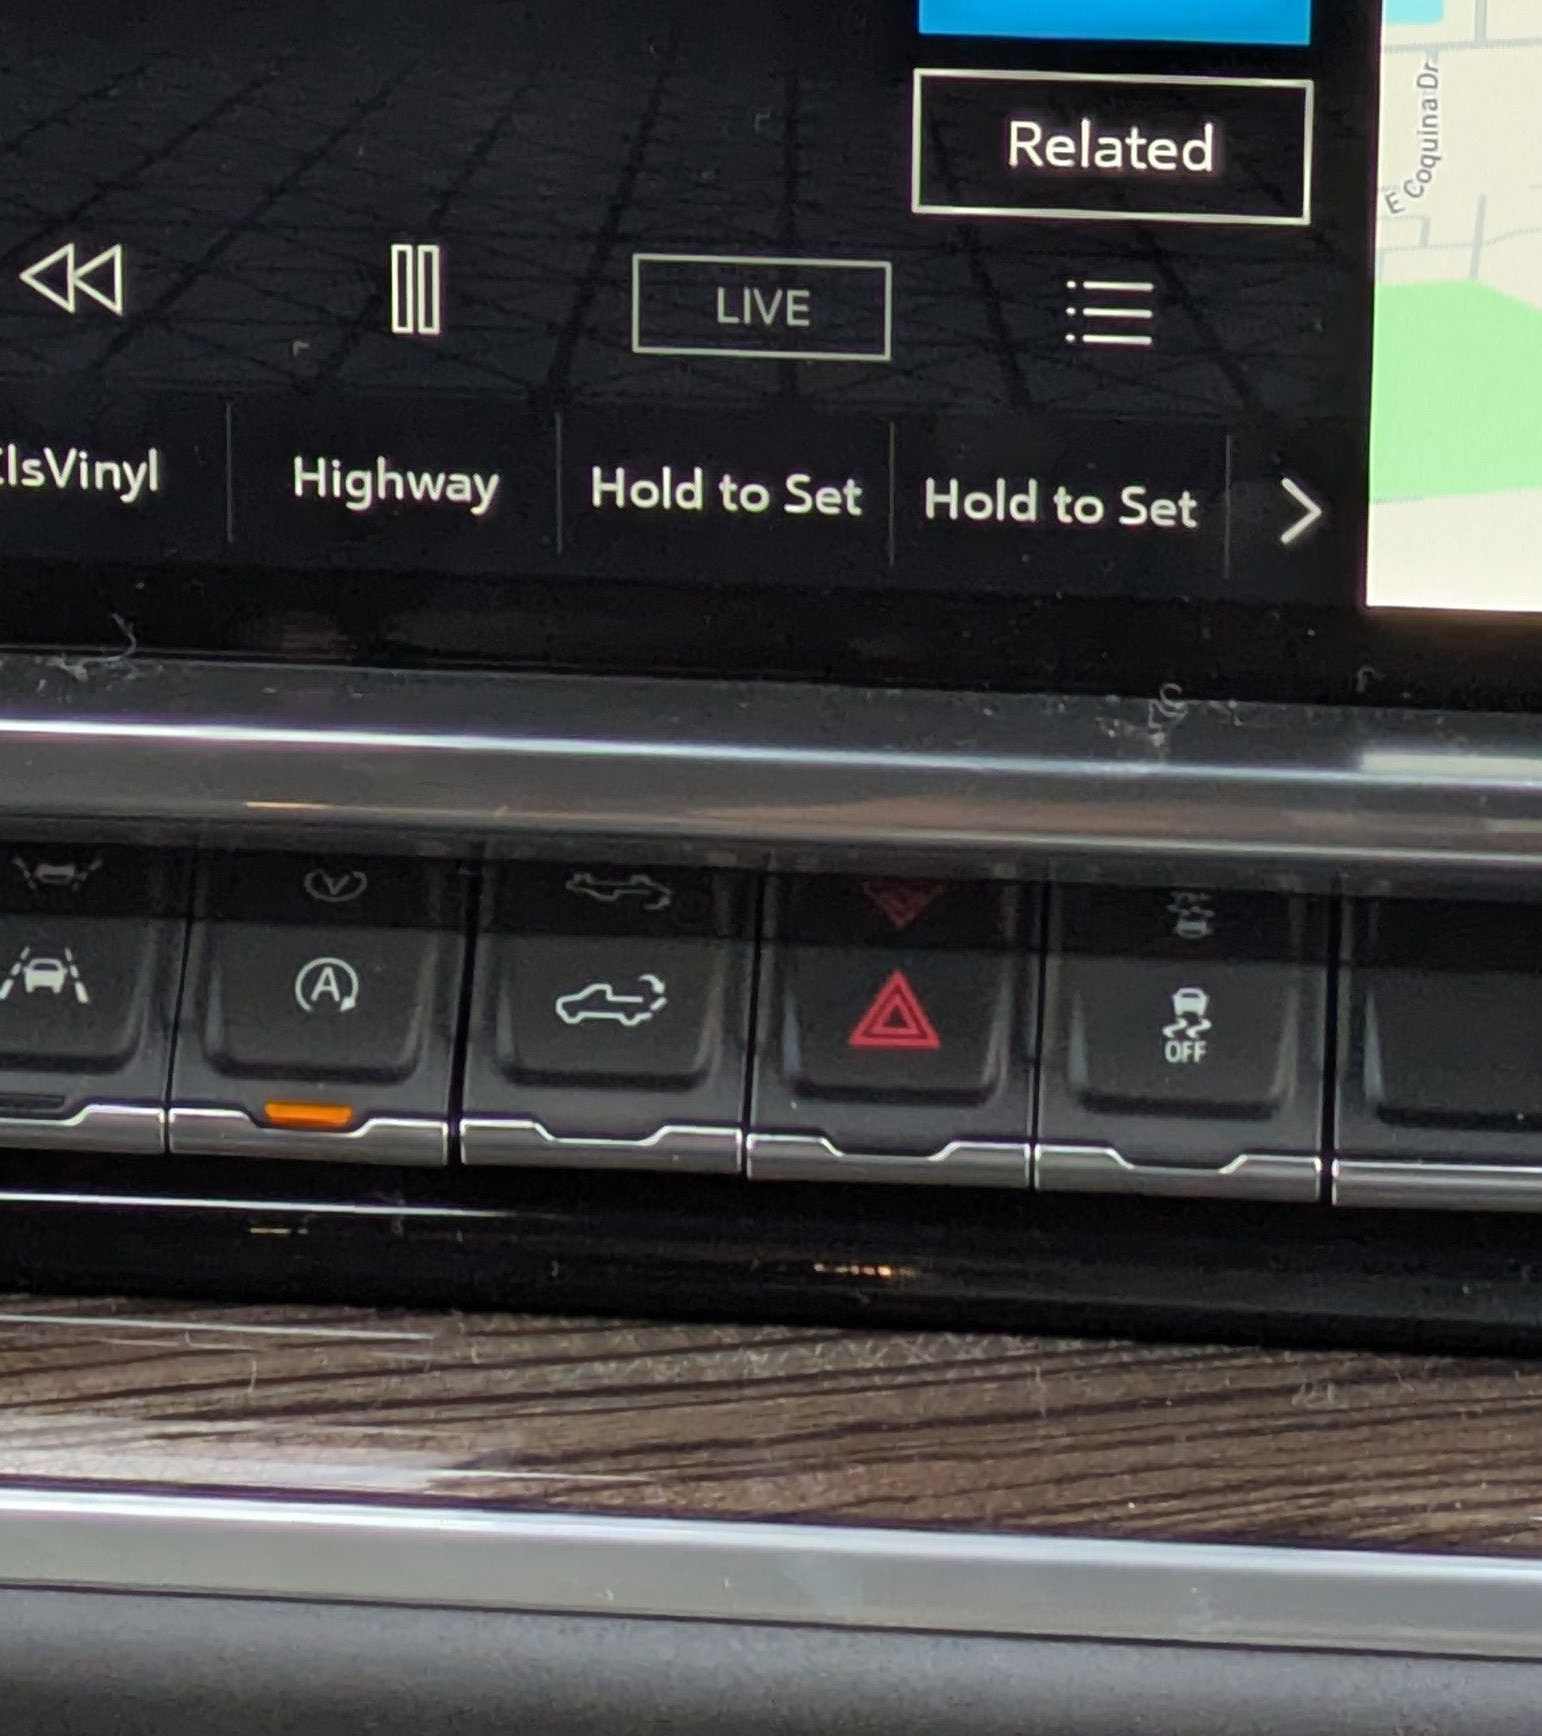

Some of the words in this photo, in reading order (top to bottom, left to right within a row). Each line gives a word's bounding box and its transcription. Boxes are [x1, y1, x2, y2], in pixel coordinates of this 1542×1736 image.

[1416, 61, 1440, 90] Dr
[1008, 117, 1214, 173] Related
[1402, 97, 1443, 199] Coquina
[1385, 190, 1406, 215] E
[718, 288, 810, 326] LIVE
[294, 456, 499, 515] Highway
[592, 466, 703, 510] Hold
[718, 474, 770, 512] to
[784, 473, 862, 516] Set
[925, 477, 1037, 522] Hold
[1053, 486, 1104, 524] to
[1119, 485, 1197, 528] Set
[1164, 1040, 1207, 1063] OFF
